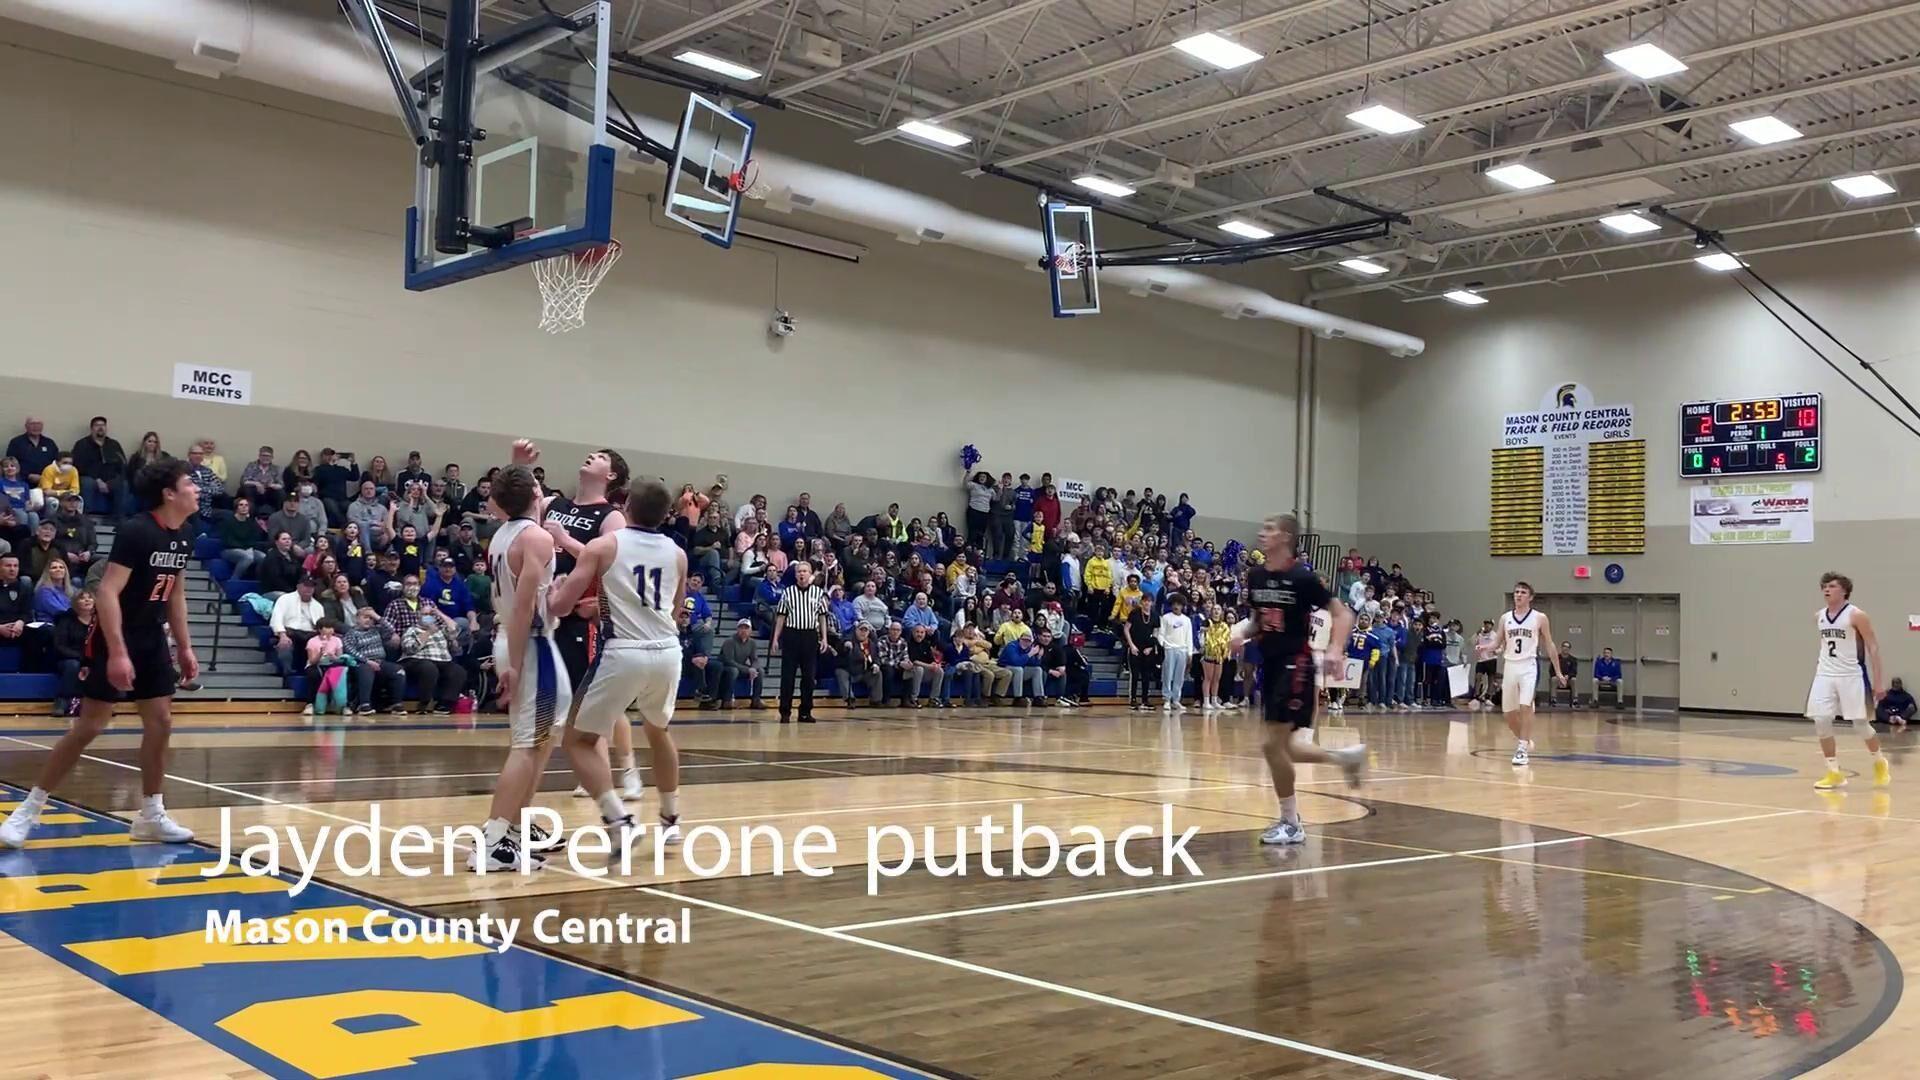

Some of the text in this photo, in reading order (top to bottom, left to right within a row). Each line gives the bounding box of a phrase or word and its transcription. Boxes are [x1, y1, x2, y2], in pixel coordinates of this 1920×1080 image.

[193, 370, 232, 386] MCC
[181, 384, 242, 400] PARENTS
[1686, 406, 1710, 414] HOME
[1784, 397, 1817, 407] VISITOR
[1506, 408, 1630, 425] MASON COUNTY CENTRAL
[1730, 400, 1778, 421] 2:53
[1798, 409, 1816, 427] 10
[1505, 418, 1632, 435] TRACK & FIELD RECORDS
[1700, 416, 1712, 434] 2
[1760, 426, 1766, 440] 1
[1506, 437, 1528, 446] BOYS
[1603, 430, 1630, 440] GIRLS
[1693, 454, 1702, 468] 0
[1804, 448, 1814, 462] 2
[1066, 482, 1084, 492] MCC
[1762, 498, 1808, 506] WATSON
[546, 509, 596, 531] ORIOLES
[148, 574, 176, 602] 21
[632, 564, 663, 610] 11
[1514, 638, 1522, 654] 3
[1828, 640, 1838, 658] 2
